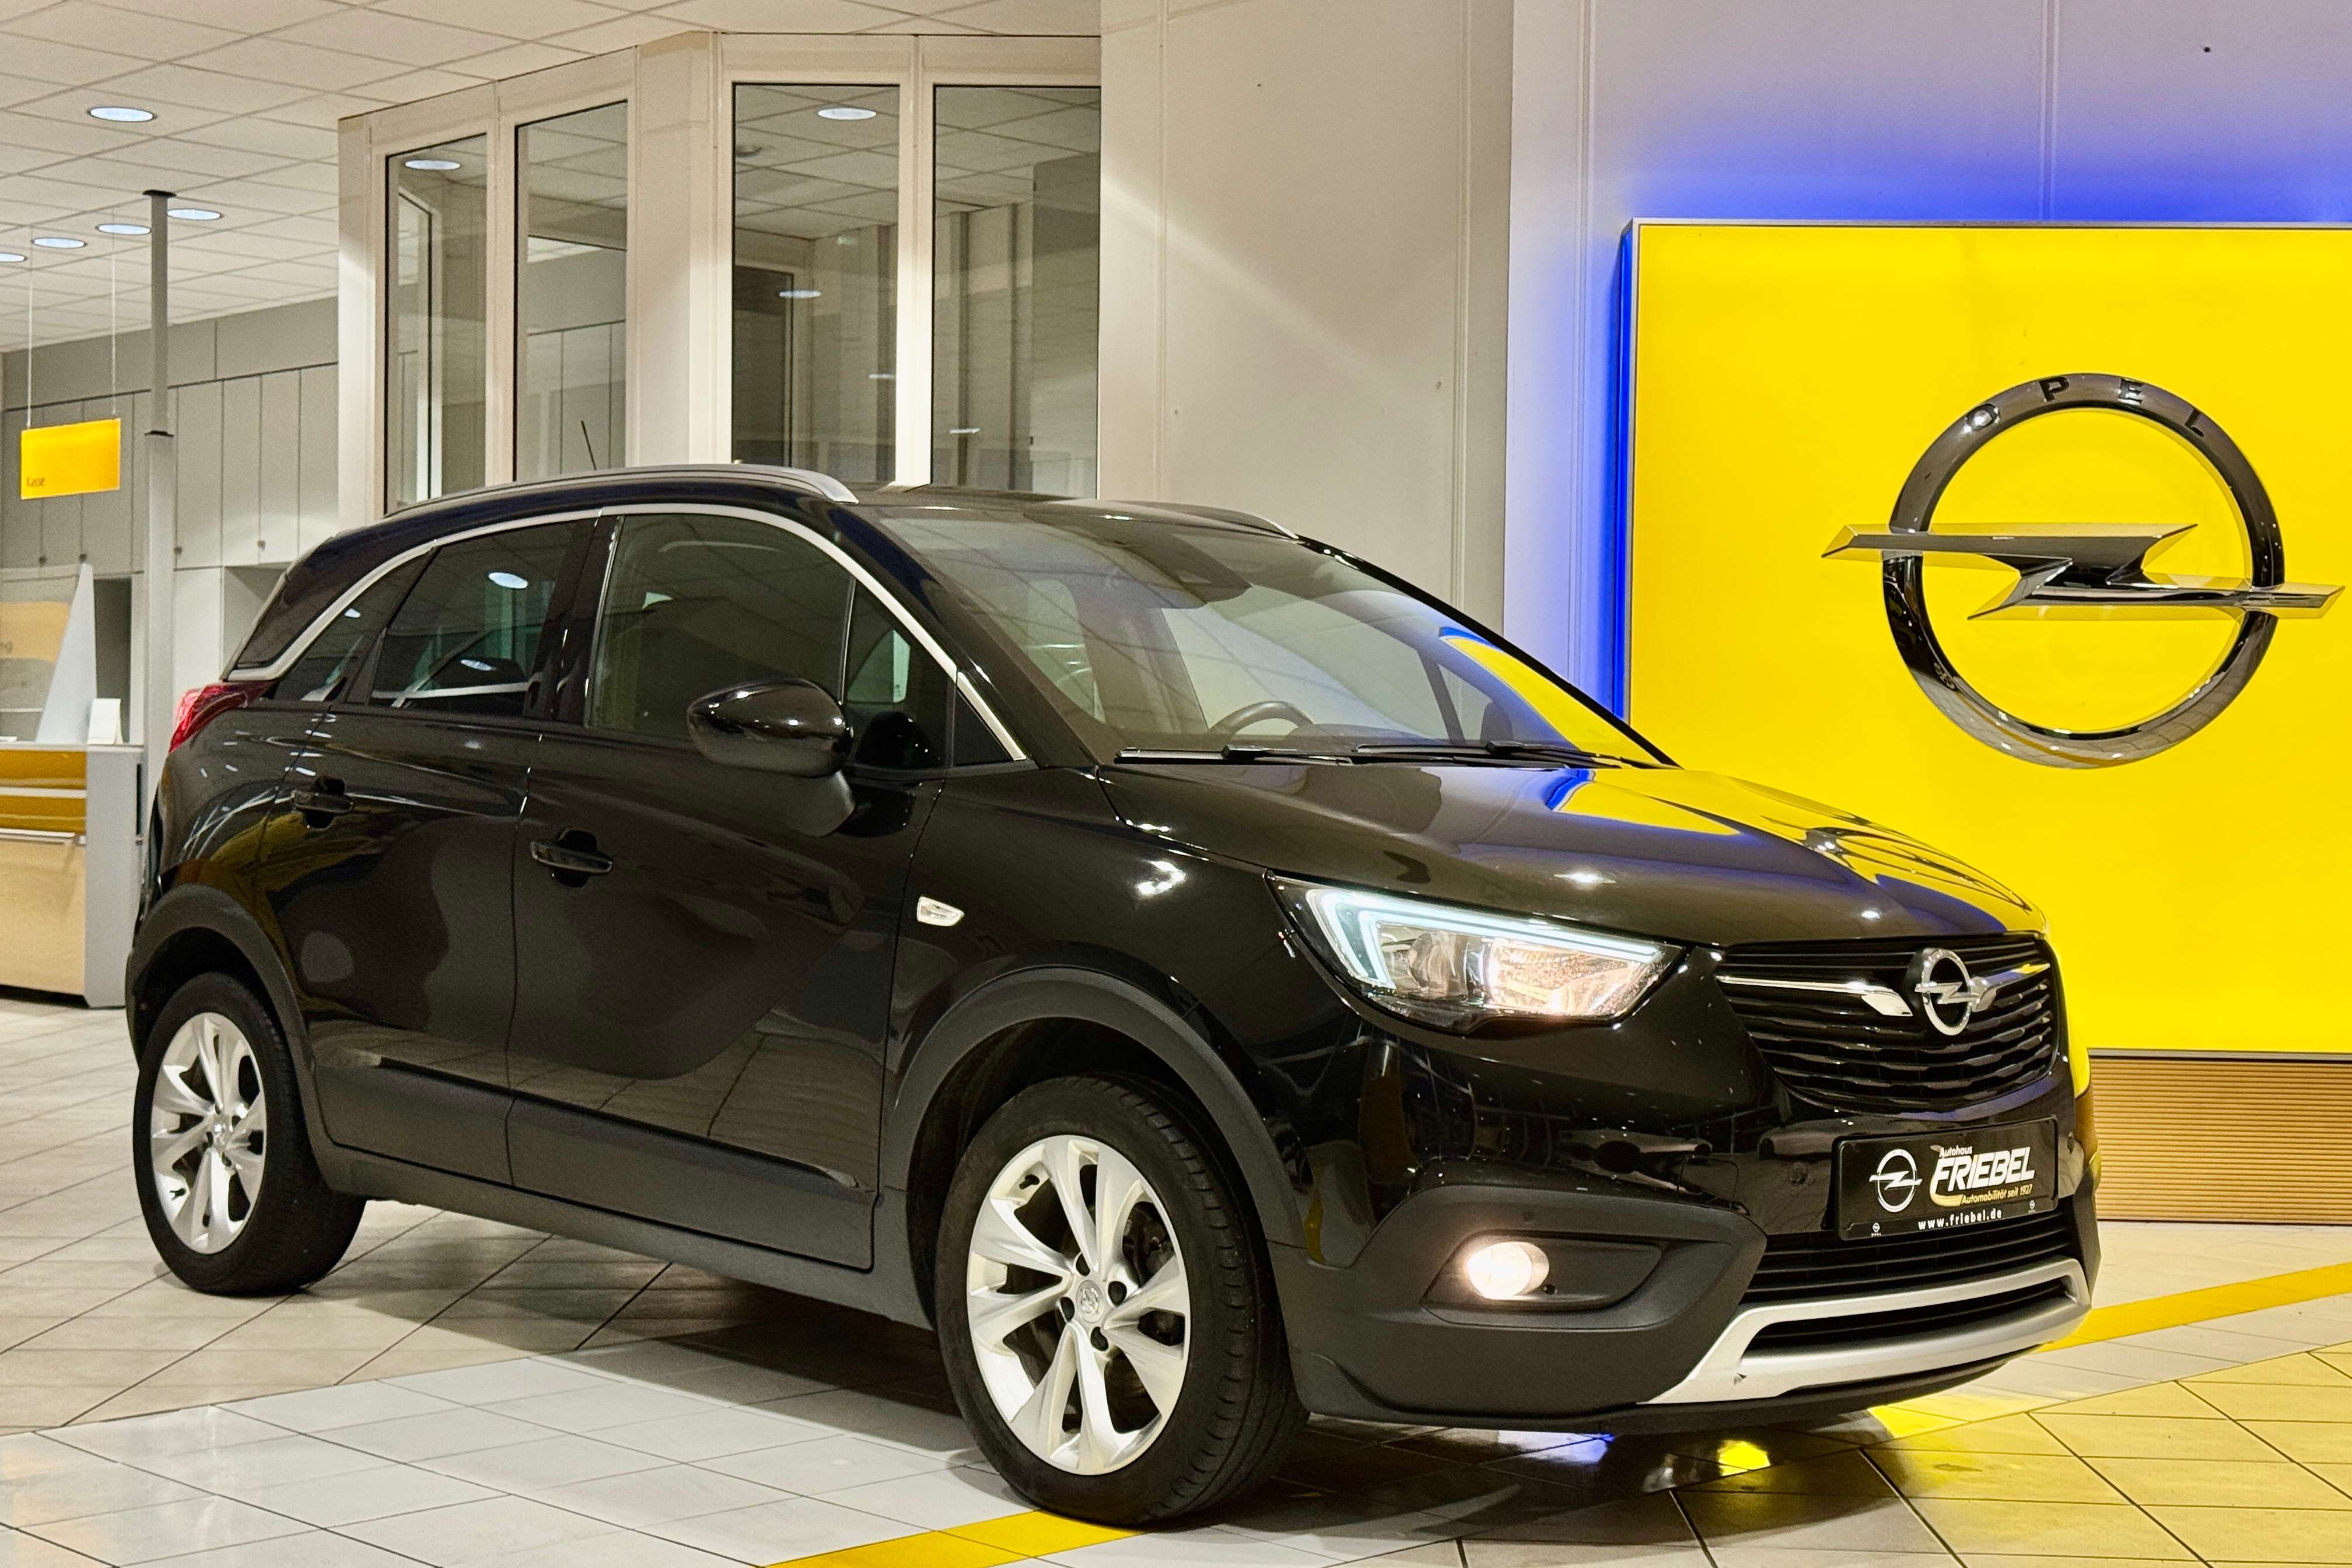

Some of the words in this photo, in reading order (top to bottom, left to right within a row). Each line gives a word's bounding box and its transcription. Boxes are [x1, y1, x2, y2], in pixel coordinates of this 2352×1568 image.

[1965, 376, 2204, 437] OPEL
[1939, 1145, 1973, 1157] Autohaus
[1933, 1147, 2035, 1194] FRIEBEL
[2008, 1186, 2019, 1198] seit
[2020, 1184, 2034, 1195] 1927
[1918, 1208, 2002, 1230] www.friebel.de
